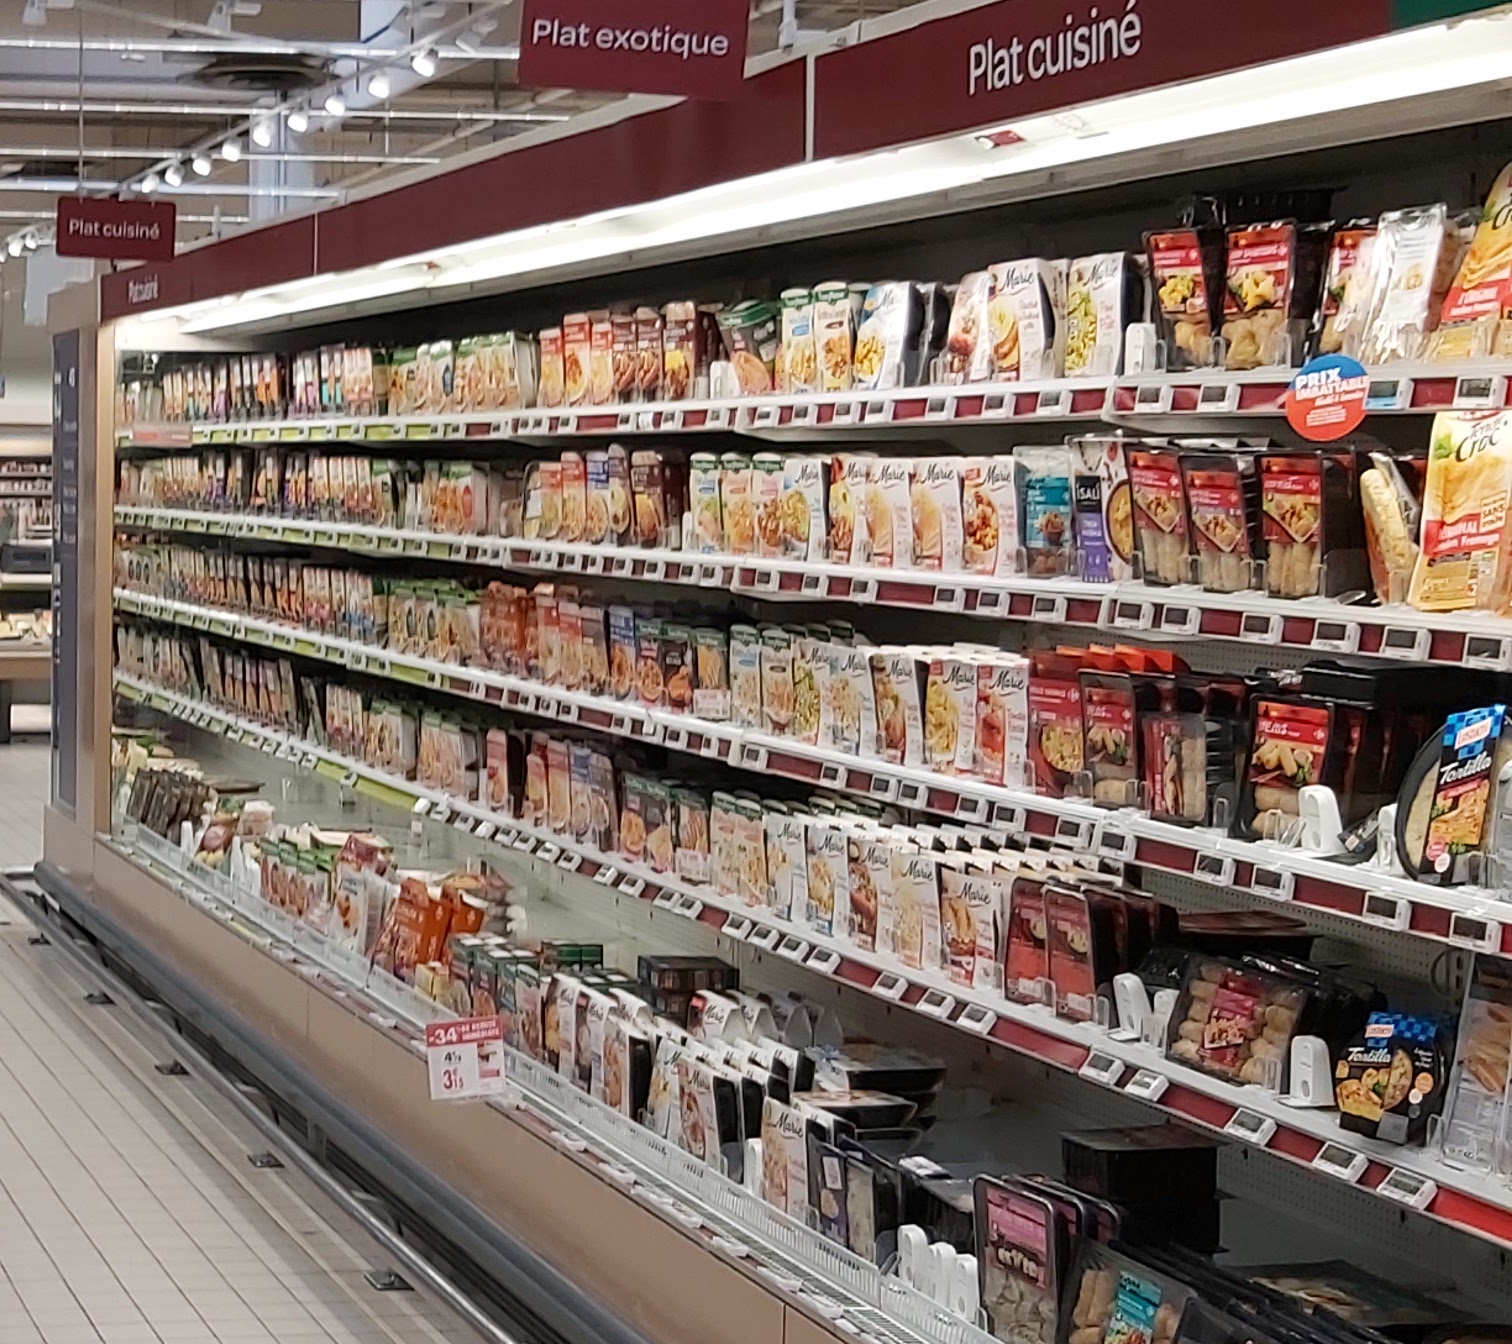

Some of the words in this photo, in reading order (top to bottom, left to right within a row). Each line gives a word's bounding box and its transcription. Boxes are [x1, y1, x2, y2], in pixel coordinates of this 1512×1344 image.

[531, 17, 591, 48] Plat
[595, 24, 730, 60] exotique
[968, 36, 1024, 96] Plat
[68, 218, 102, 237] Plat
[102, 220, 160, 240] cuisiné
[999, 266, 1035, 291] Marie
[1296, 367, 1342, 389] PRIX
[873, 462, 905, 485] Marie
[919, 462, 955, 485] Marie
[943, 664, 975, 685] Marie
[990, 670, 1025, 690] Marie
[1440, 751, 1492, 784] Tortilla
[958, 882, 991, 904] Marie
[1348, 1047, 1391, 1063] Tortilla
[773, 1112, 803, 1138] Marie
